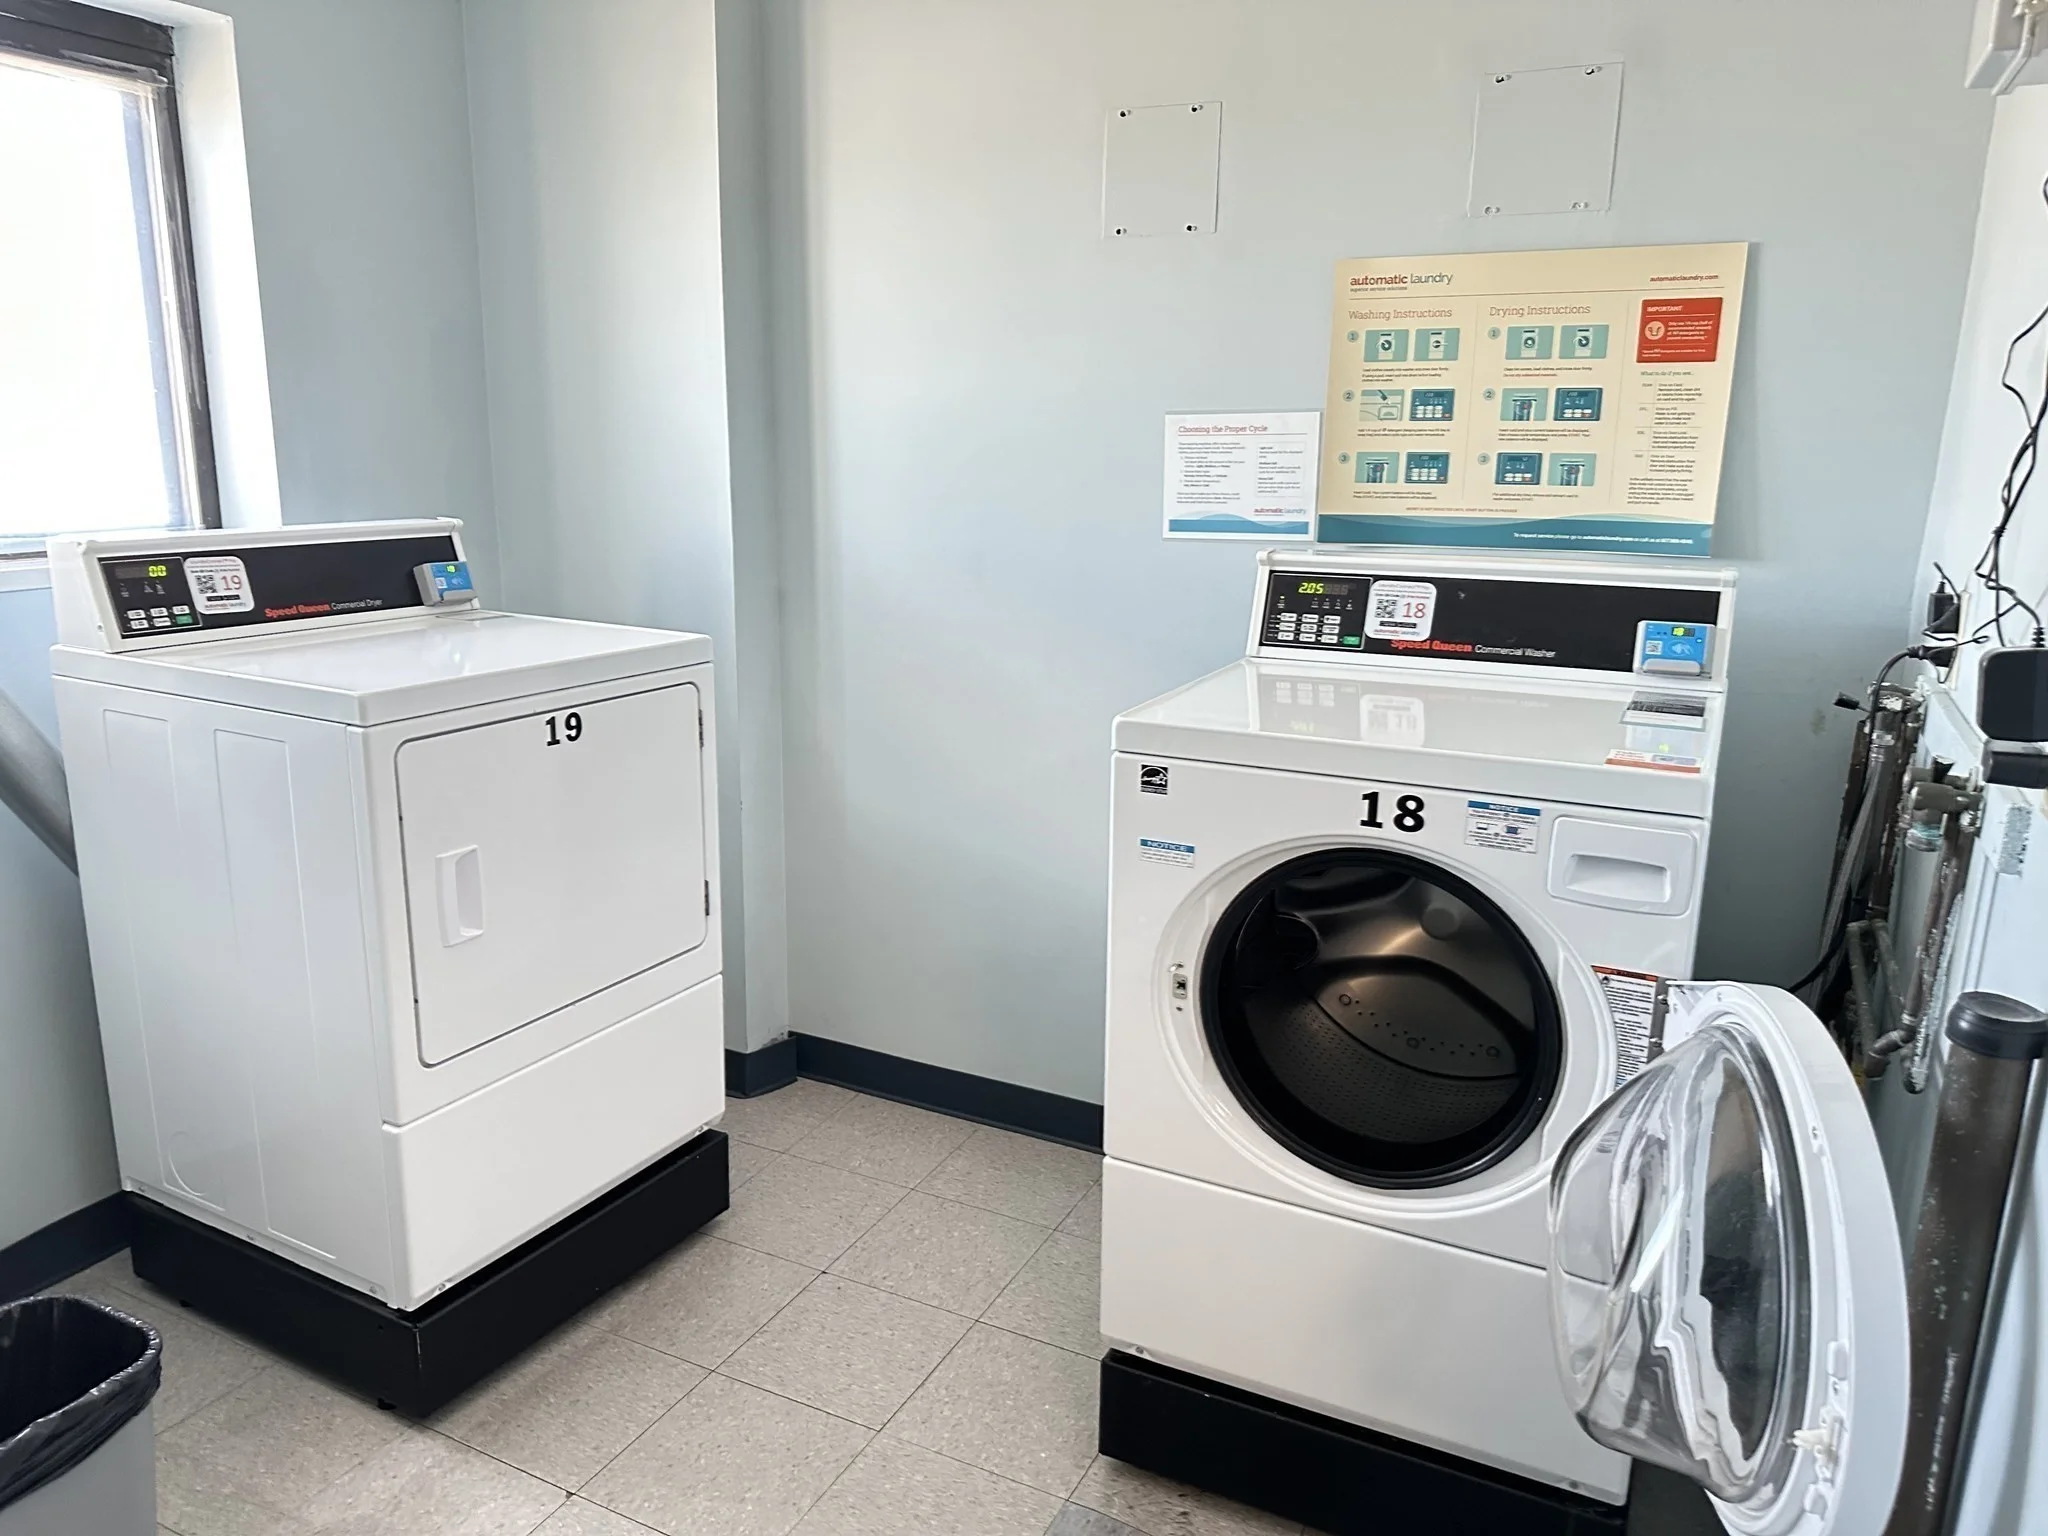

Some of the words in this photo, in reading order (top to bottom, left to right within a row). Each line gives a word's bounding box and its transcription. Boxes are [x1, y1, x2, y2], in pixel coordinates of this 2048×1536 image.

[1350, 274, 1408, 286] automatic
[1410, 272, 1453, 285] laundry
[1650, 274, 1719, 282] automaticlaundry.com
[1348, 310, 1391, 321] Washing
[1393, 309, 1452, 319] Instructions
[1489, 306, 1524, 318] Drying
[1526, 305, 1591, 315] Instructions
[1178, 426, 1210, 435] Choosing
[1212, 425, 1223, 433] the
[1224, 426, 1247, 434] Proper
[1248, 425, 1268, 433] Cycle
[220, 574, 243, 591] 19
[264, 605, 298, 618] Speed
[298, 604, 331, 613] Queen
[331, 599, 366, 610] Commercial
[366, 599, 383, 607] Dryer
[1402, 602, 1426, 619] 18
[1390, 640, 1430, 650] Speed
[1431, 641, 1473, 652] Queen
[1475, 644, 1523, 656] Commercial
[1524, 647, 1557, 658] Washer
[545, 712, 583, 747] 19
[1359, 790, 1425, 833] 18
[1488, 804, 1520, 812] NOTICE
[1147, 841, 1187, 852] NOTICE
